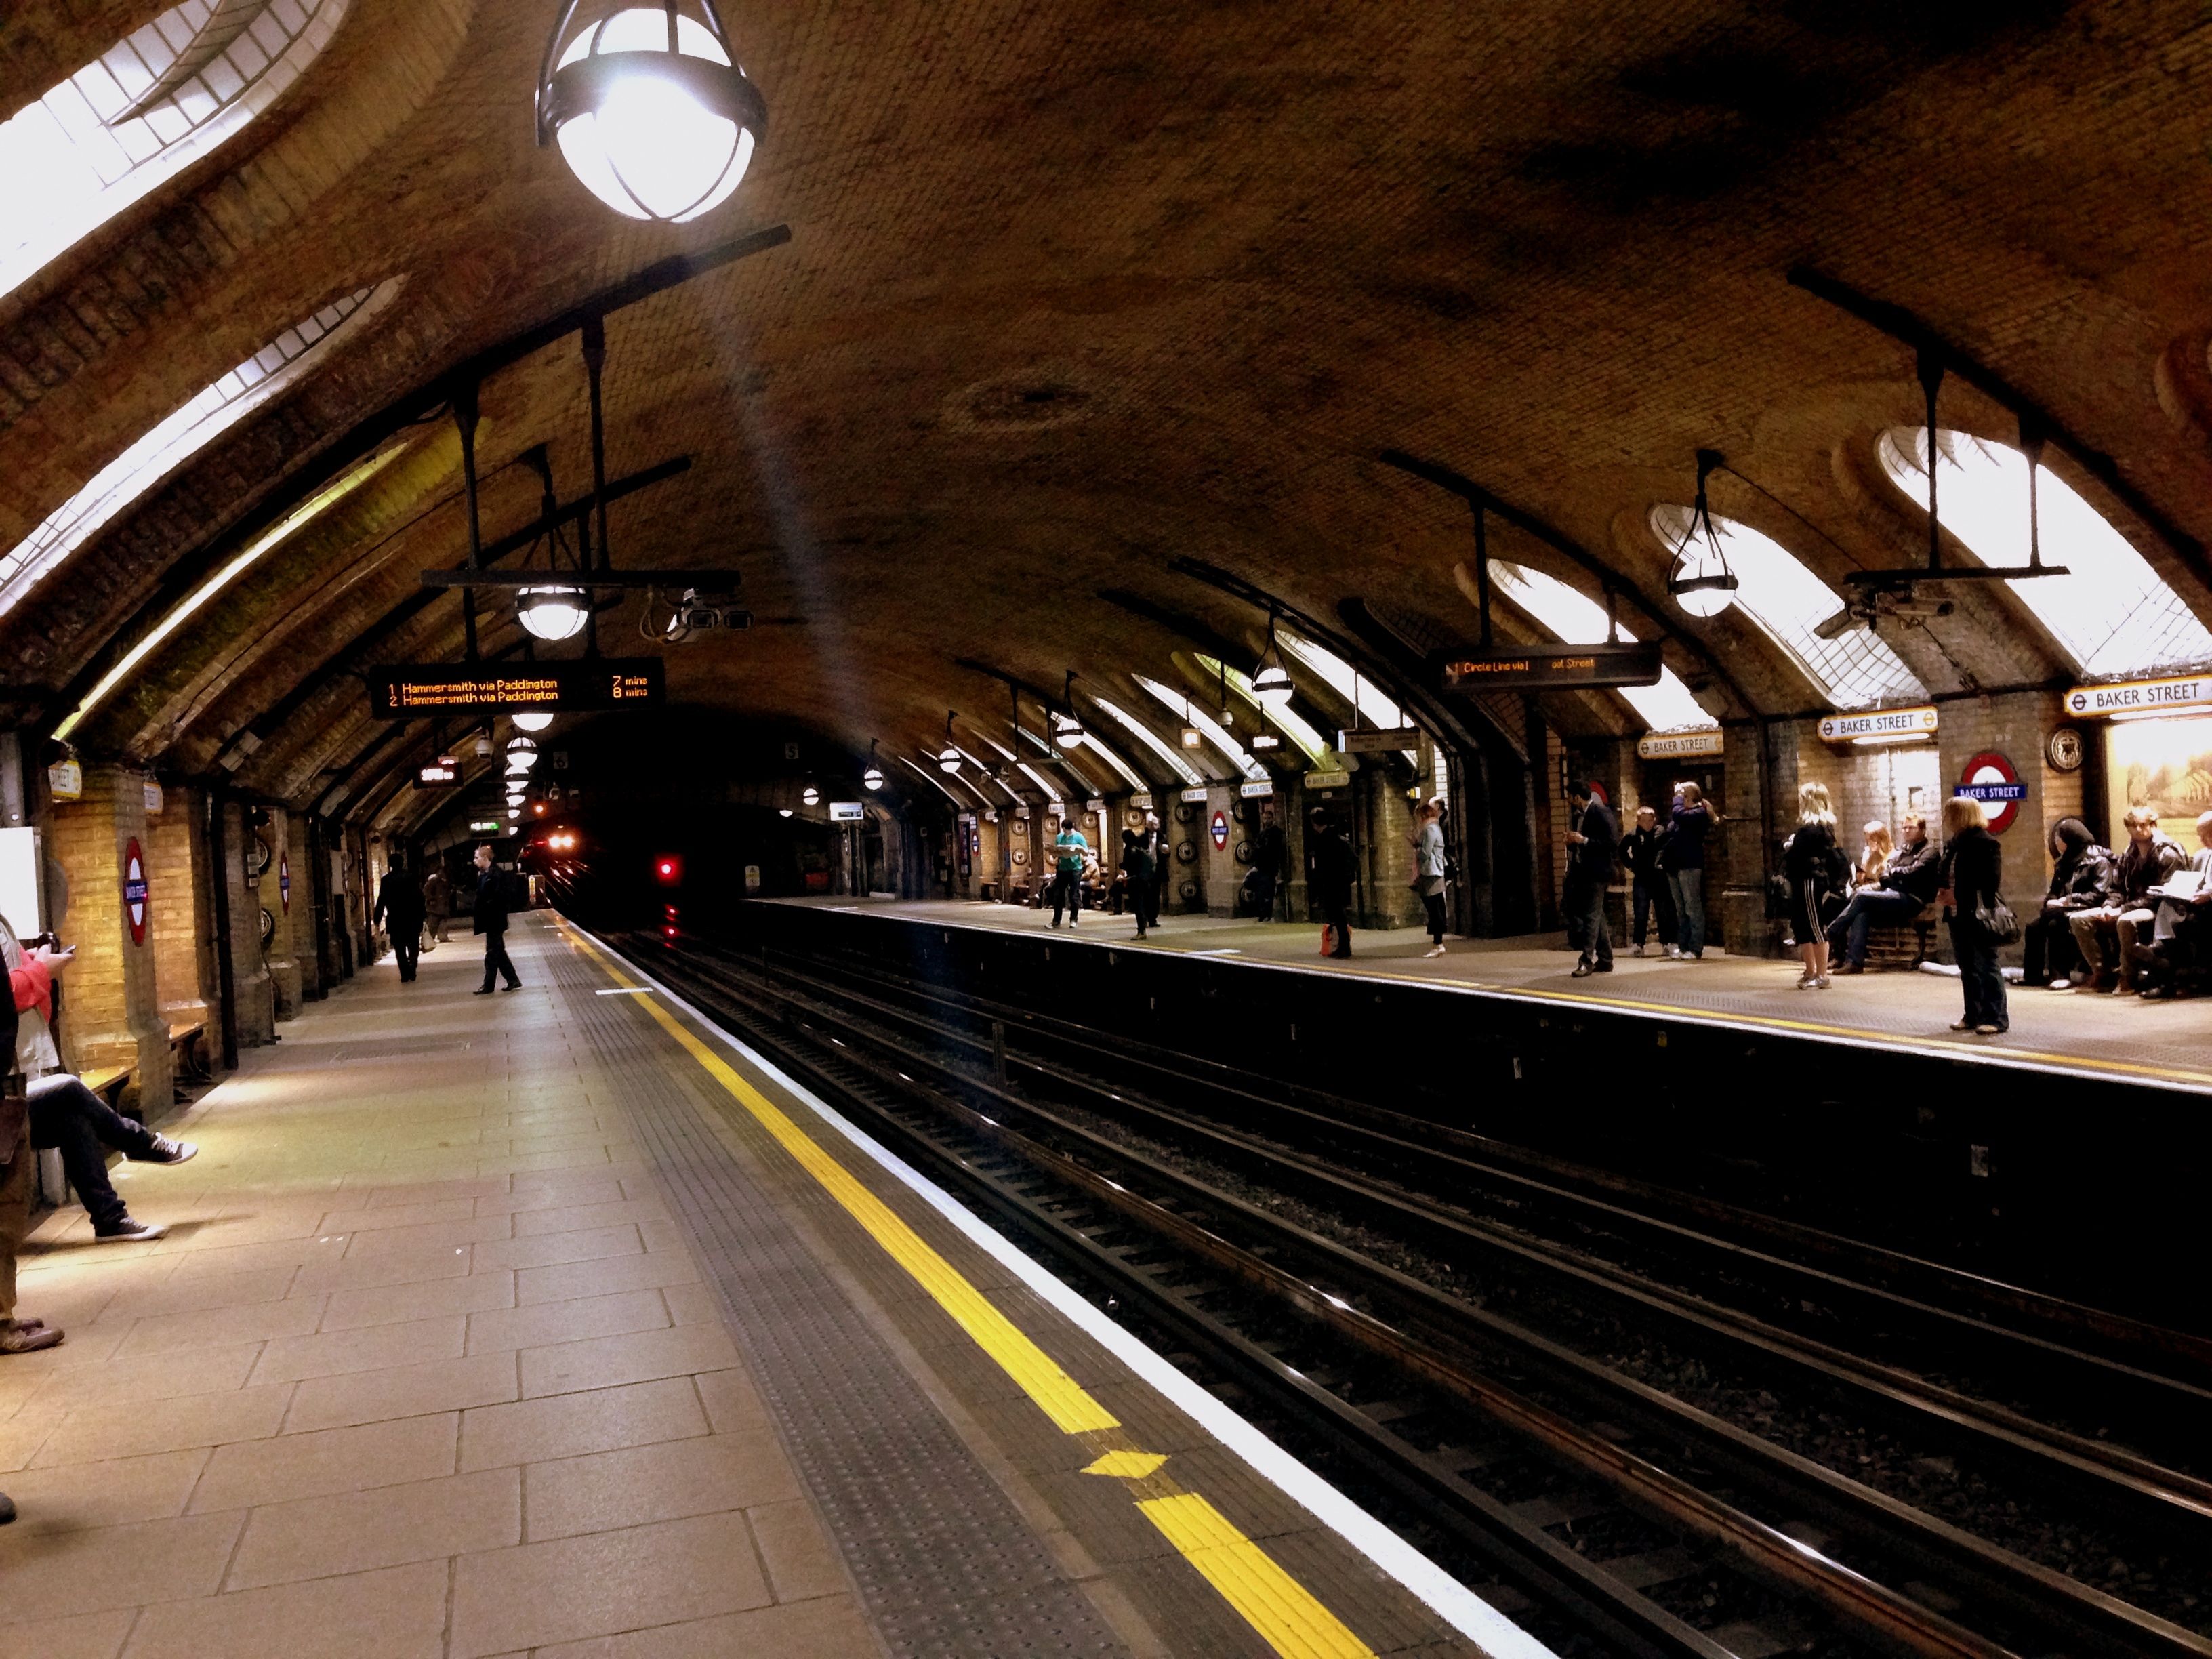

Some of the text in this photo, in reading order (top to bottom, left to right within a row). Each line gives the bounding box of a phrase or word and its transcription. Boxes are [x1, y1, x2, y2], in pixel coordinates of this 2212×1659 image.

[1464, 661, 1491, 673] Circle
[1492, 662, 1511, 672] Line
[1512, 661, 1524, 671] via
[388, 675, 647, 695] 1 Hammersmith via Paddington 7 mins
[2097, 682, 2200, 707] BAKER STREET
[390, 687, 648, 707] 2 Hammersmith via Paddington 8 mins
[1841, 714, 1914, 734] BAKER STREET
[1654, 738, 1708, 752] BAKER STREET
[1960, 787, 2020, 798] BAKER STREET
